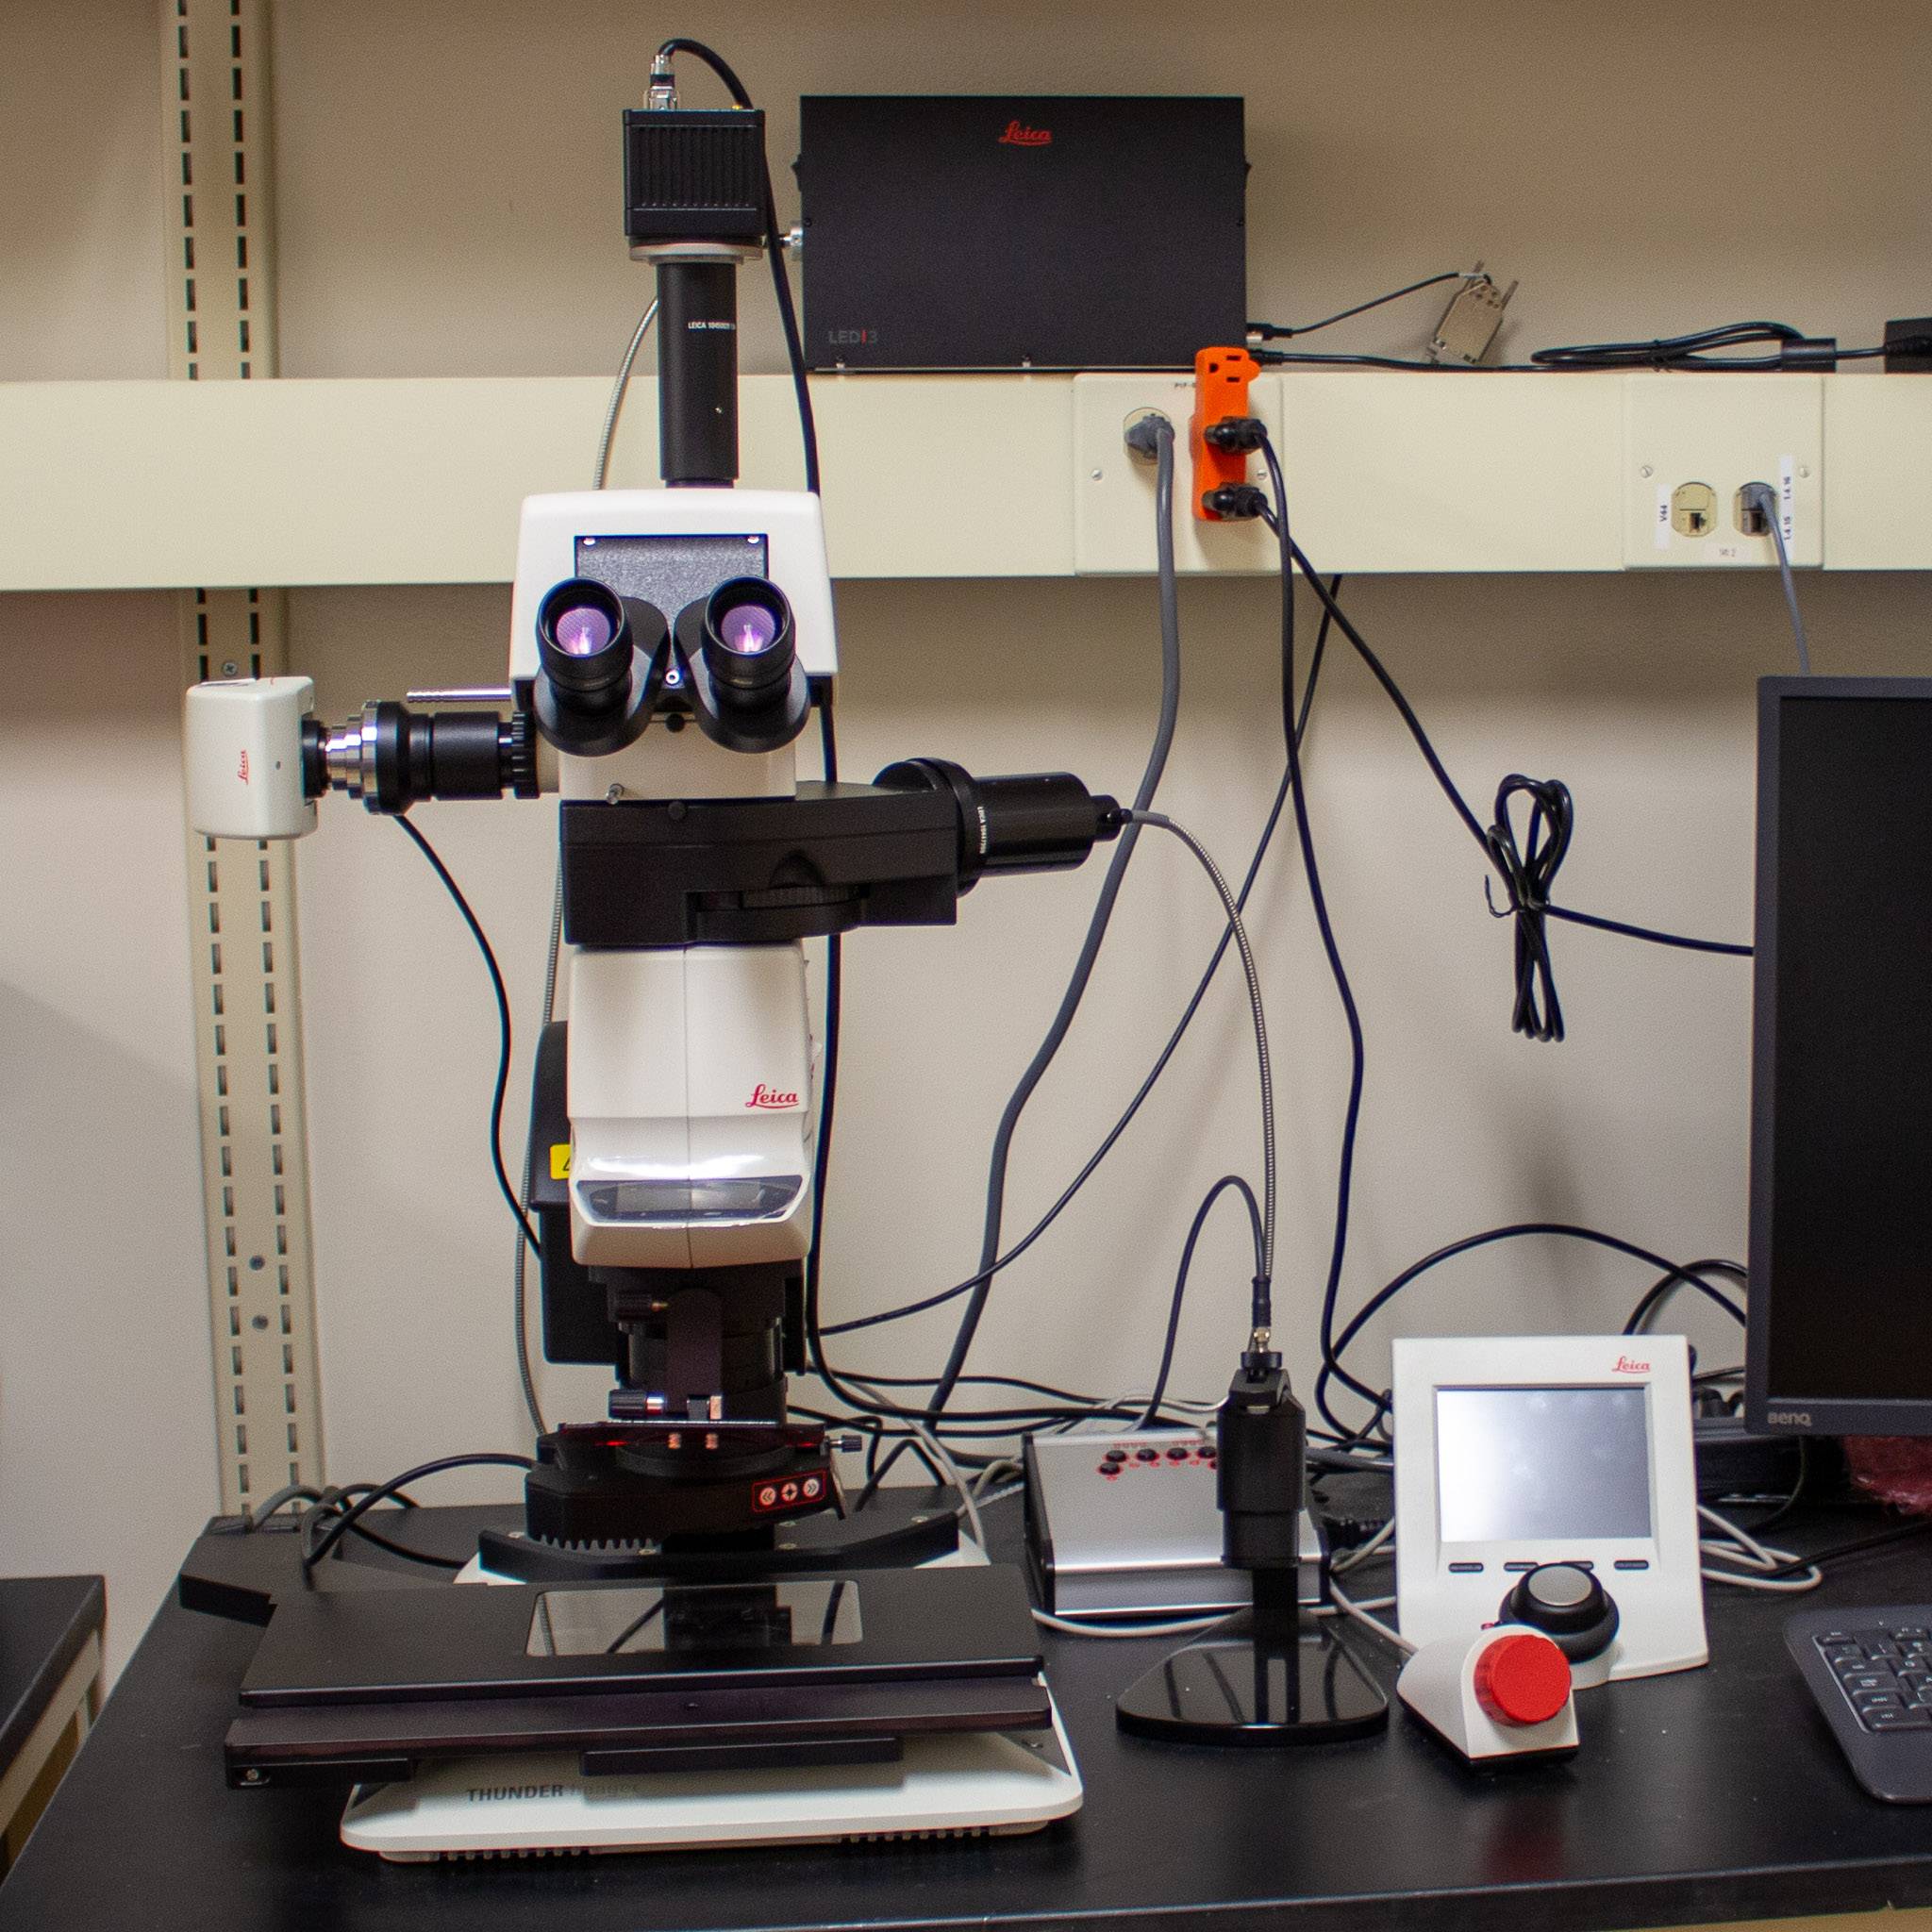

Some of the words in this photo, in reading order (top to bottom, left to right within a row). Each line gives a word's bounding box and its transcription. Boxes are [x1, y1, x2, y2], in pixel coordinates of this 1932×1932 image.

[997, 120, 1052, 146] Leica
[237, 749, 249, 785] Leica
[976, 806, 986, 824] LEICA
[745, 1083, 799, 1109] Leica
[1611, 1356, 1651, 1374] Leica
[1767, 1411, 1812, 1427] BenQ
[467, 1784, 565, 1802] THUNDER
